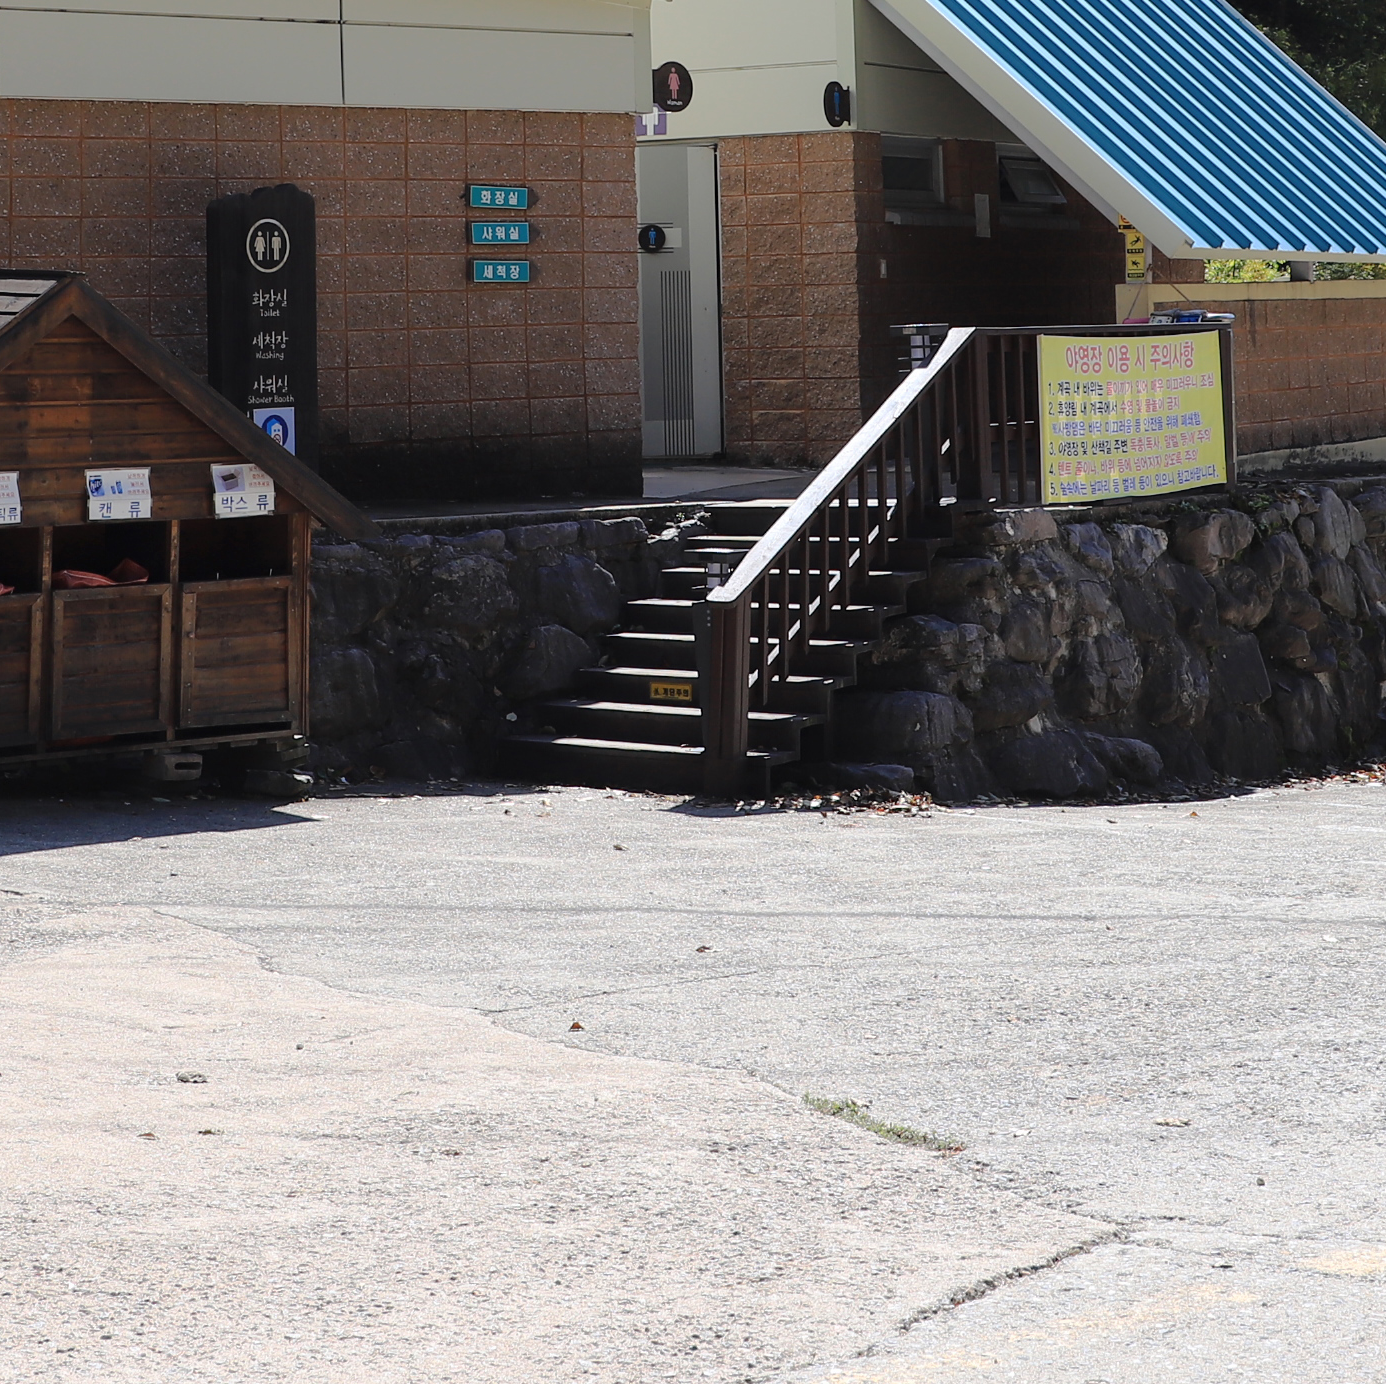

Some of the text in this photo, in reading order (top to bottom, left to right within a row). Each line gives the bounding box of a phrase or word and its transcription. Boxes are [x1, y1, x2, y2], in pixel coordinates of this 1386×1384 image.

[480, 190, 518, 205] 화장실
[482, 226, 519, 240] 샤워실
[483, 264, 520, 279] 세척장
[252, 289, 287, 307] 화장실
[259, 309, 280, 317] Toilet
[252, 331, 289, 349] 세척장
[256, 351, 284, 360] Washing
[1066, 341, 1194, 373] 야영장 이용 시 주의사항
[253, 375, 288, 393] 샤워실
[1048, 373, 1214, 396] 1. 계곡 내 바위는 물이끼가 있어 매우 미끄러우니 조심
[247, 395, 294, 404] Shower Booth
[1048, 396, 1180, 416] 2. 휴양림 내 계곡에서 수영 및 물놀이 금지
[1089, 420, 1102, 435] 바닥
[1105, 419, 1133, 434] 미끄러움
[1135, 418, 1141, 433] 등
[1143, 416, 1164, 432] 안전을
[1166, 415, 1178, 429] 위해
[1049, 441, 1056, 456] 3.
[1058, 441, 1079, 456] 야영장
[1081, 441, 1088, 455] 및
[1091, 440, 1112, 455] 산책길
[1114, 438, 1128, 453] 주변
[1197, 428, 1211, 443] 주의
[1049, 463, 1056, 476] 4.
[1058, 461, 1072, 476] 텐트
[1101, 459, 1115, 474] 바위
[1117, 458, 1132, 473] 등에
[1134, 455, 1162, 472] 넘어지지
[1184, 449, 1198, 462] 주의
[1050, 482, 1058, 496] 5.
[1060, 481, 1088, 496] 숲속에는
[1090, 479, 1111, 495] 날파리
[1113, 478, 1119, 493] 등
[1123, 476, 1136, 492] 벌레
[1138, 474, 1152, 490] 등이
[1155, 472, 1175, 487] 있으니
